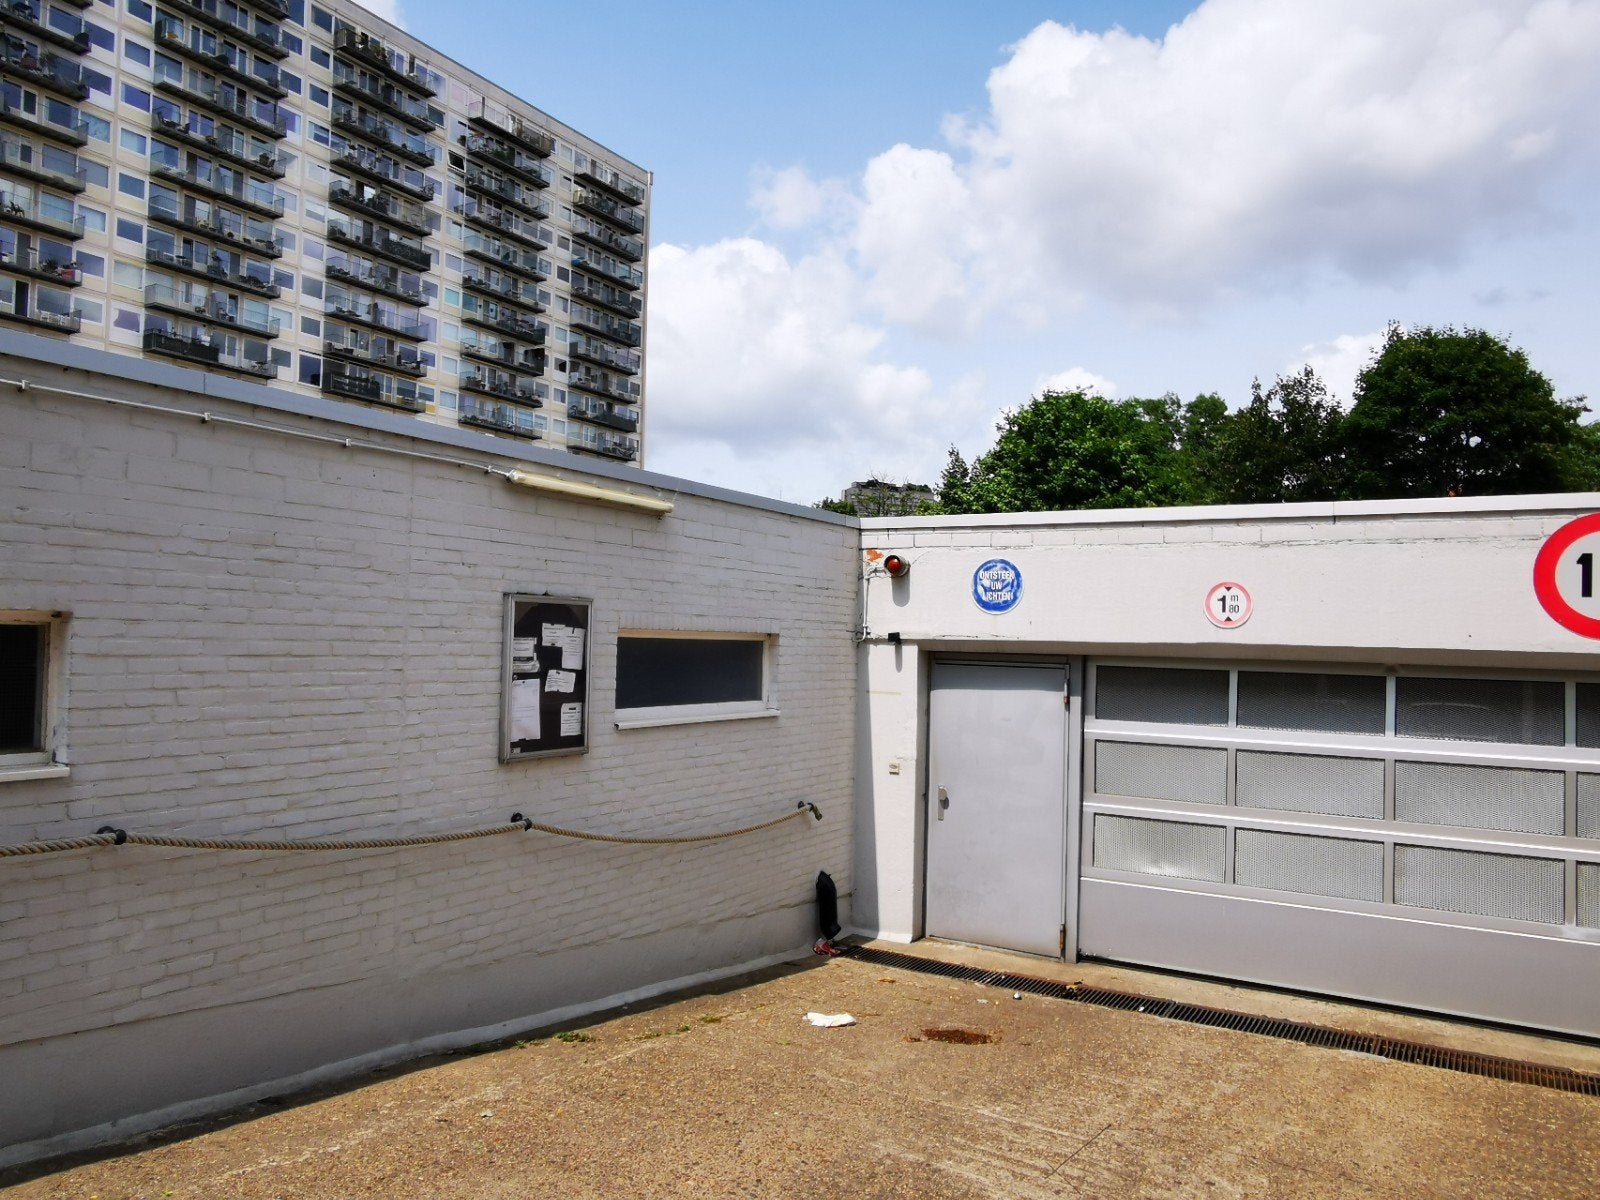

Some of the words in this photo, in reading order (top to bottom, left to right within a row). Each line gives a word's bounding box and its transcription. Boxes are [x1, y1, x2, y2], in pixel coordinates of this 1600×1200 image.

[980, 570, 1014, 580] ONTSTEEK
[1576, 552, 1593, 598] 1
[990, 580, 1003, 590] UW
[1217, 595, 1226, 613] 1
[1228, 604, 1240, 613] 80
